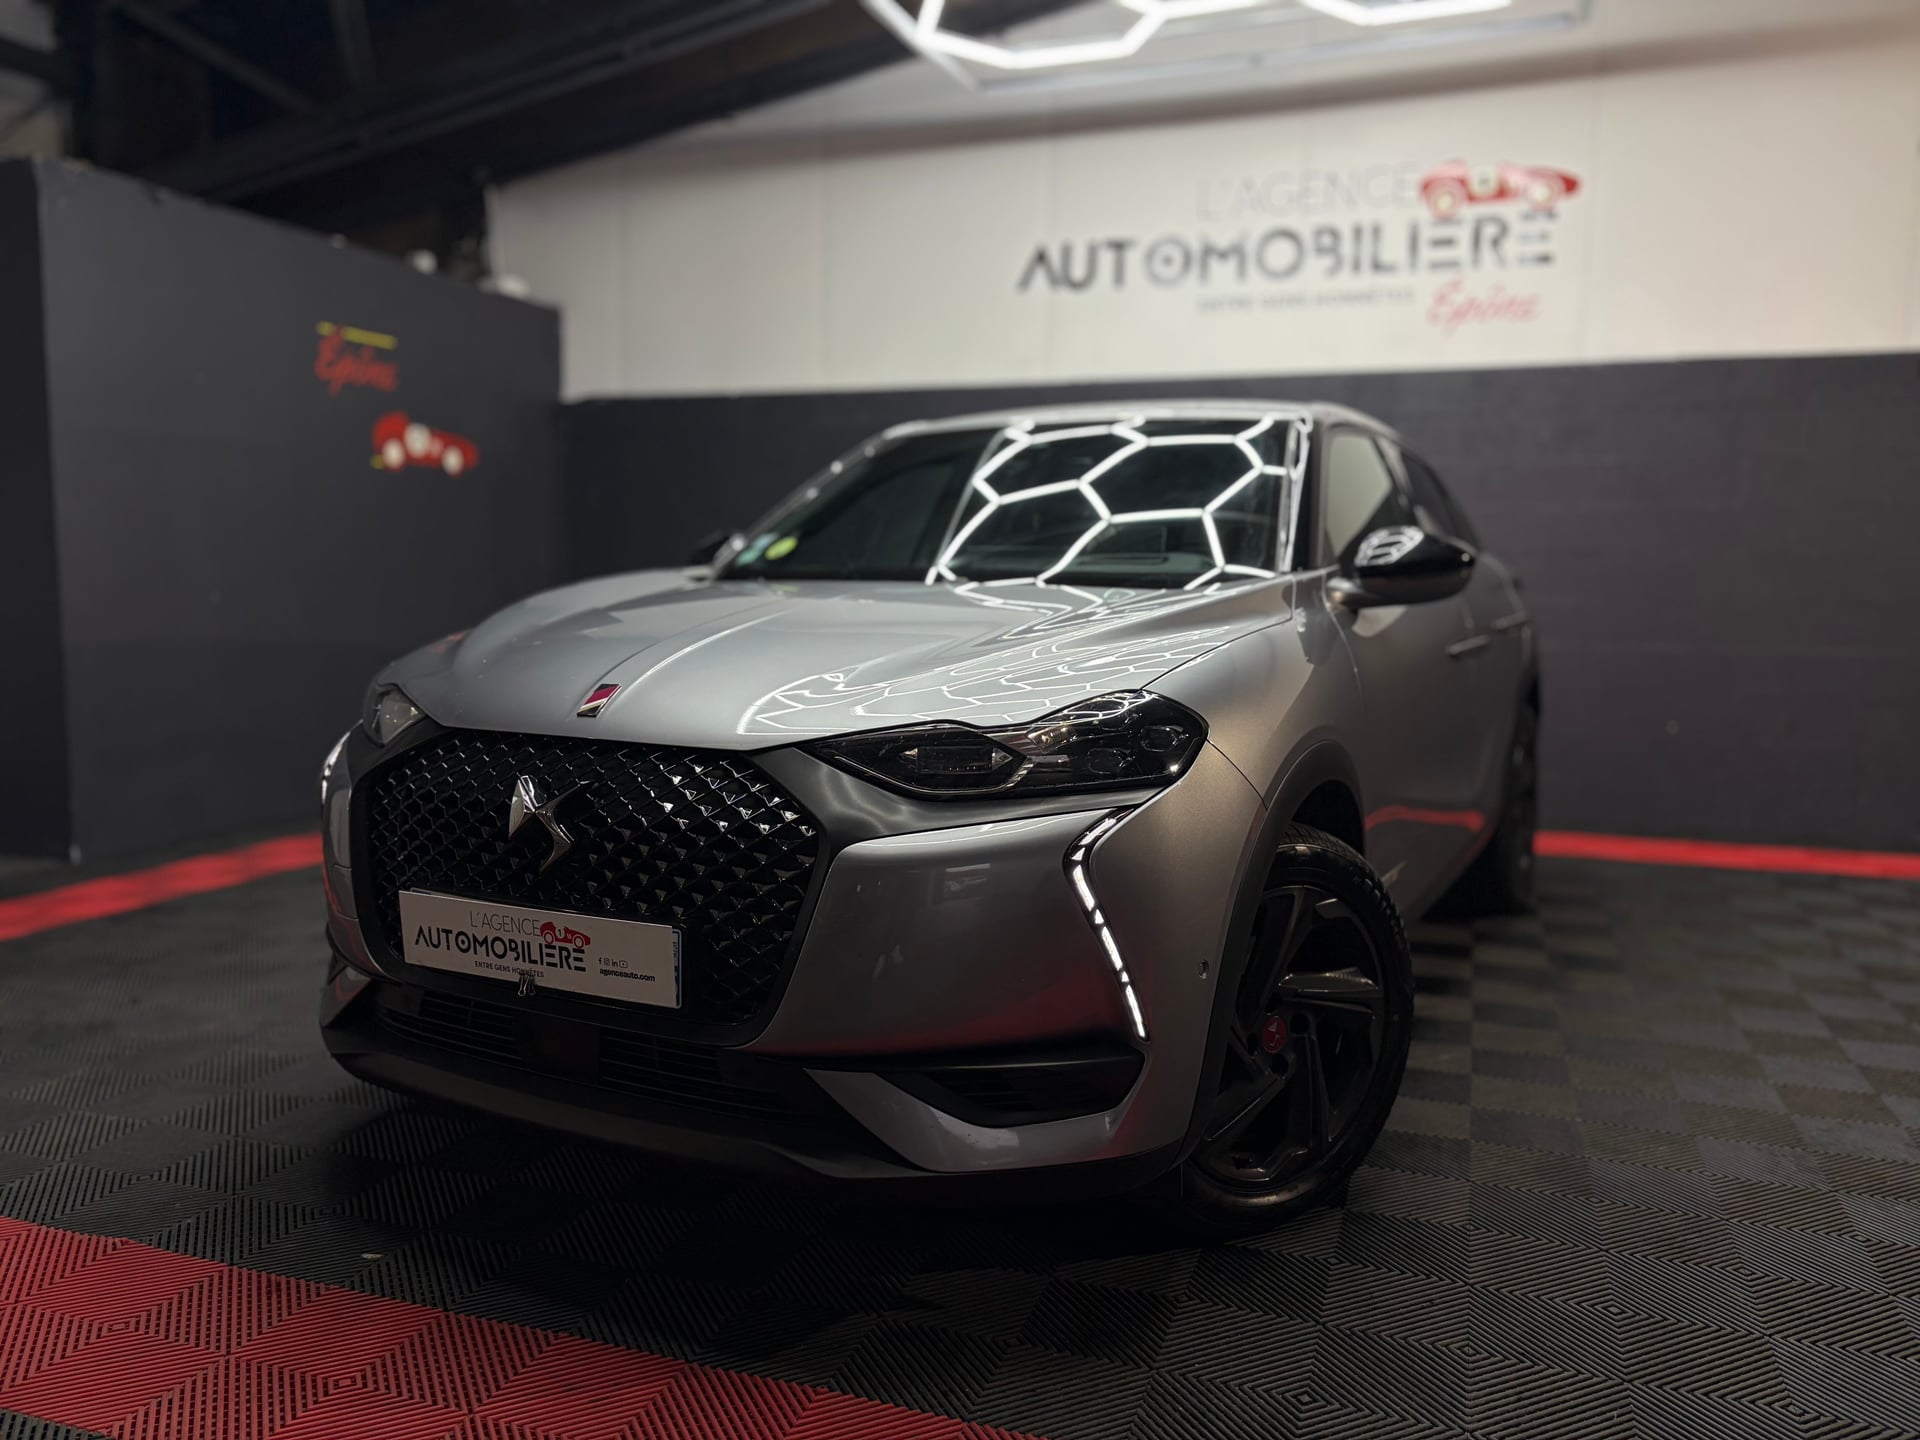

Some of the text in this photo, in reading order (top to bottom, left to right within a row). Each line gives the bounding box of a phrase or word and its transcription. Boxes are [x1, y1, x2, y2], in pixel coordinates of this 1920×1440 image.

[1197, 162, 1418, 220] L'AGENCE
[470, 911, 540, 936] L'AGENCE
[475, 961, 493, 970] ENTRE
[495, 964, 510, 973] GENS
[600, 969, 655, 981] agenceauto.com
